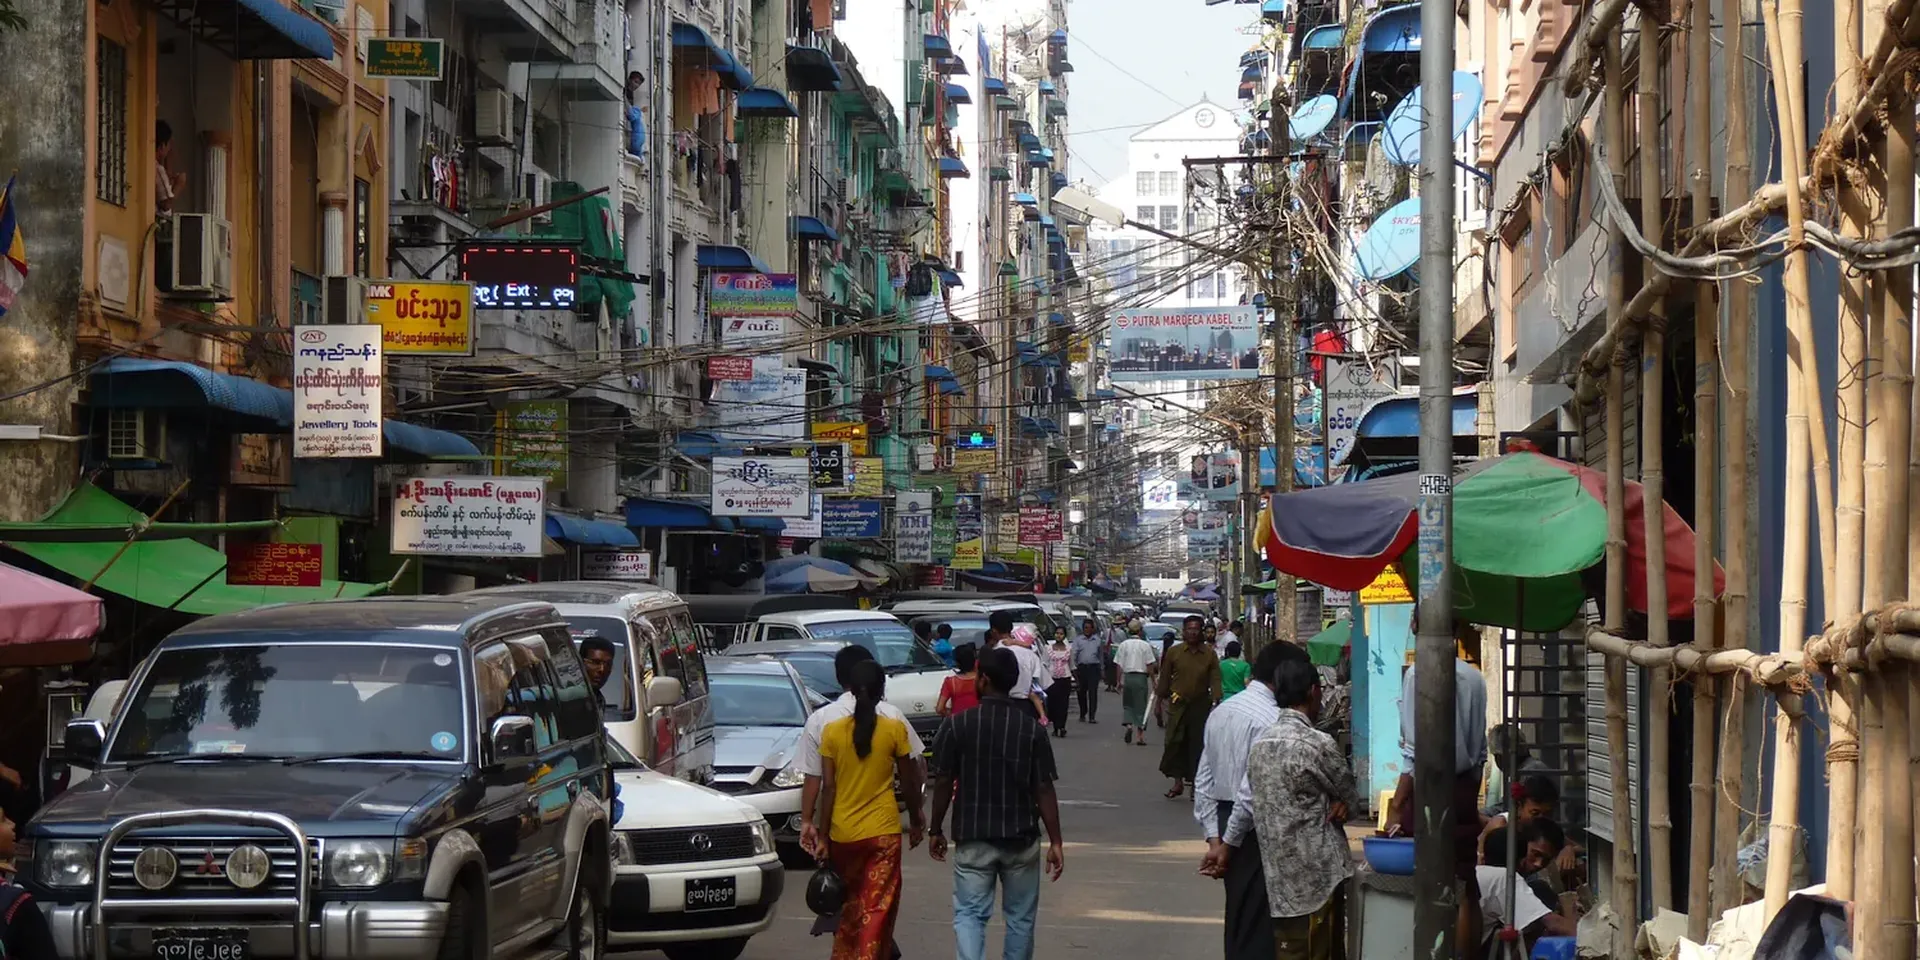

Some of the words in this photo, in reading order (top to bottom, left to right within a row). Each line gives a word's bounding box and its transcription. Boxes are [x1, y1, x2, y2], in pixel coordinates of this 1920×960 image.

[369, 285, 391, 298] MK
[506, 281, 530, 296] Ext
[1132, 314, 1161, 327] PUTRA
[1162, 312, 1204, 326] MARDECA
[1206, 313, 1233, 325] KABEL
[303, 332, 323, 341] ZNT
[299, 420, 348, 431] Jewellery
[353, 420, 378, 430] Tools
